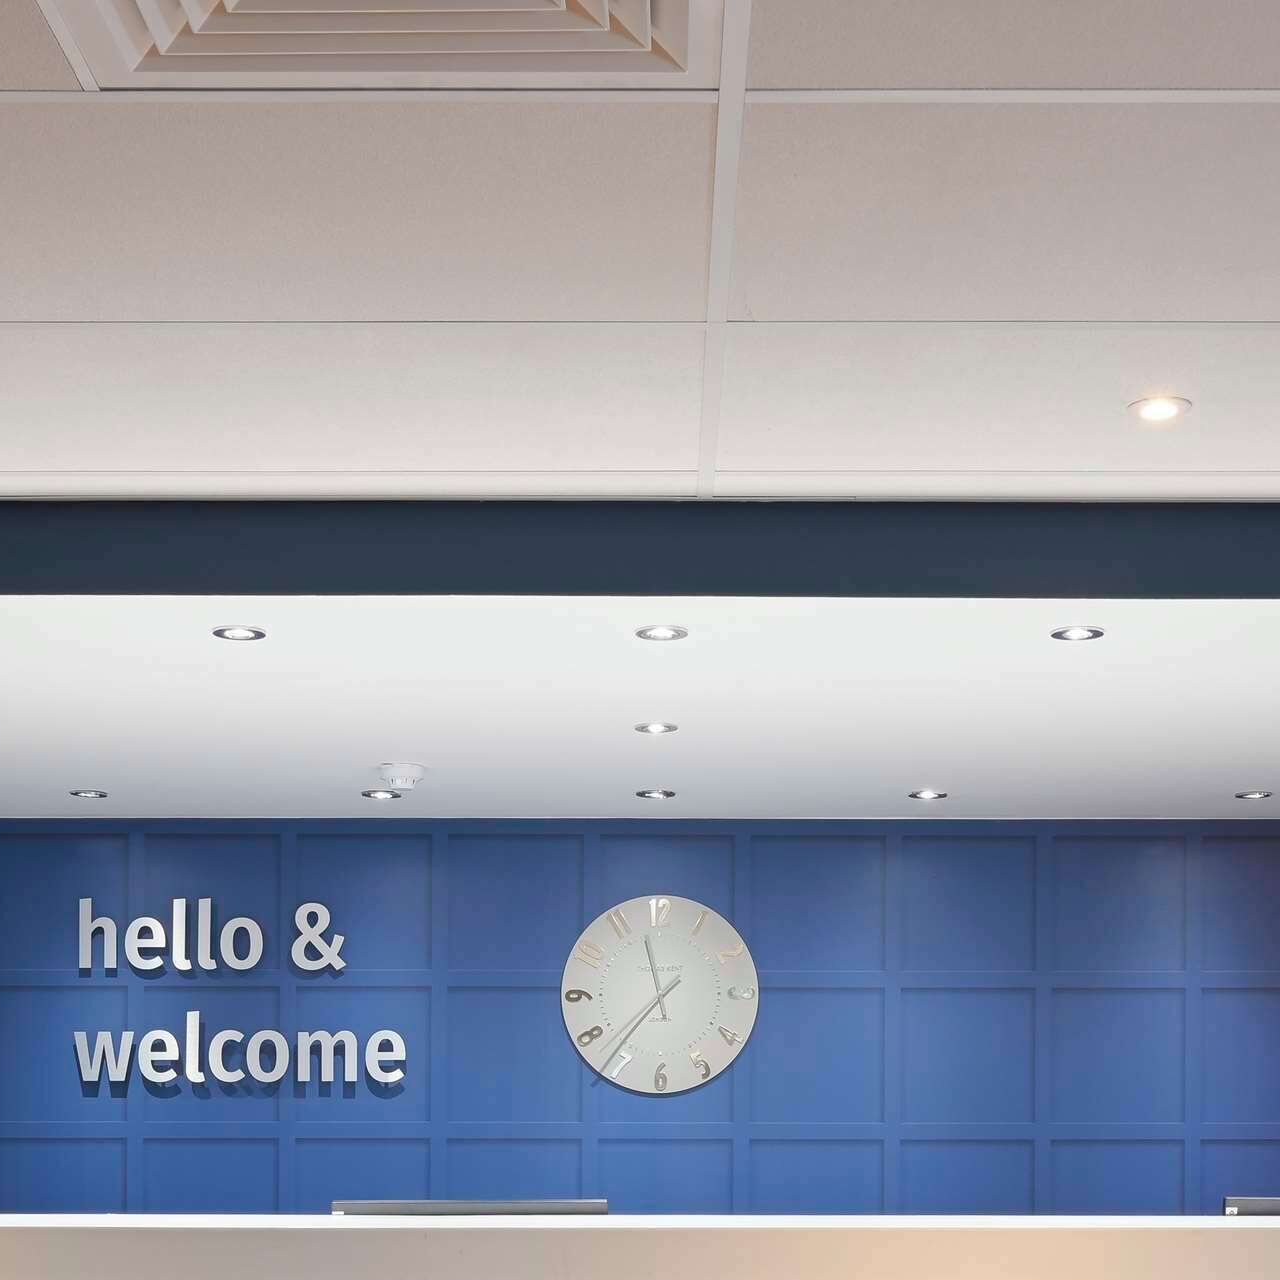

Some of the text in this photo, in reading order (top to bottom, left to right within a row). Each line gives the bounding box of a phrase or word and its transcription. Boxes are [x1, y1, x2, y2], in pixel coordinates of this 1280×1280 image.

[607, 909, 633, 939] 11
[649, 898, 672, 928] 12
[78, 898, 347, 971] hello &
[574, 942, 604, 969] 10
[565, 989, 593, 1003] 9
[727, 986, 755, 1001] 3
[73, 1010, 407, 1083] welcome
[577, 1025, 603, 1047] 8
[719, 1025, 744, 1046] 4
[609, 1051, 633, 1079] 7
[654, 1062, 668, 1092] 6
[689, 1051, 711, 1080] 5
